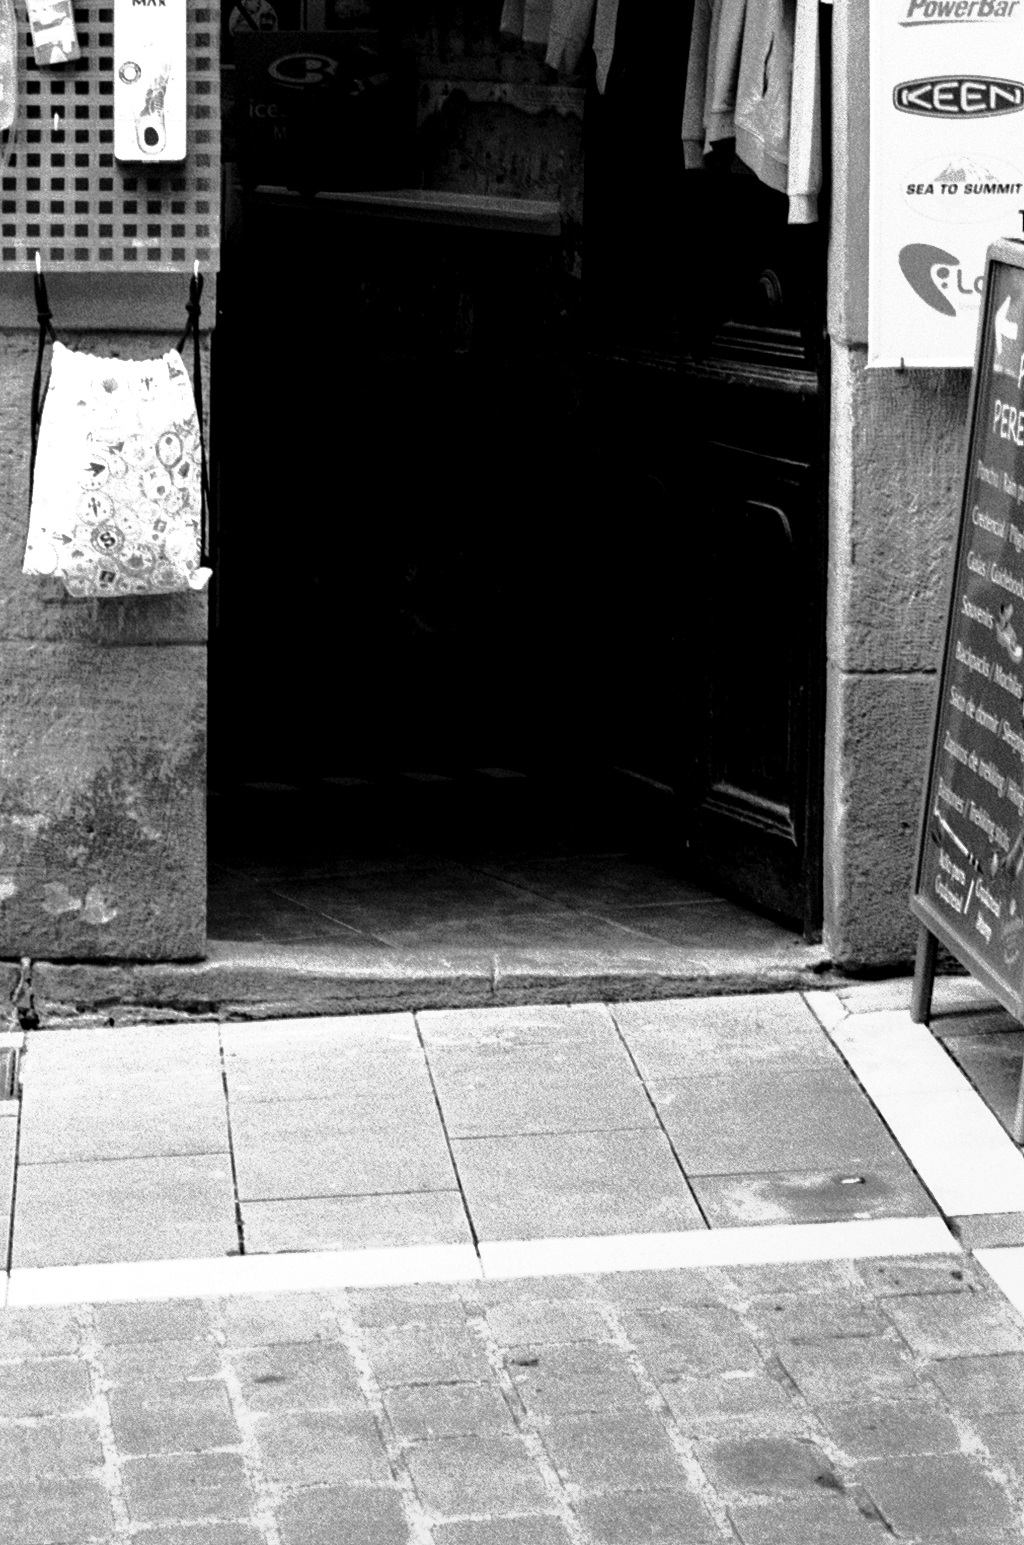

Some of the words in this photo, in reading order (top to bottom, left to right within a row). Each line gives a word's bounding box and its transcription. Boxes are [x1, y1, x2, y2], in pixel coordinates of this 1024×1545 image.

[901, 81, 1023, 112] KEEN
[906, 184, 934, 196] SEA
[940, 184, 958, 196] TO
[963, 183, 1024, 196] SUMMIT
